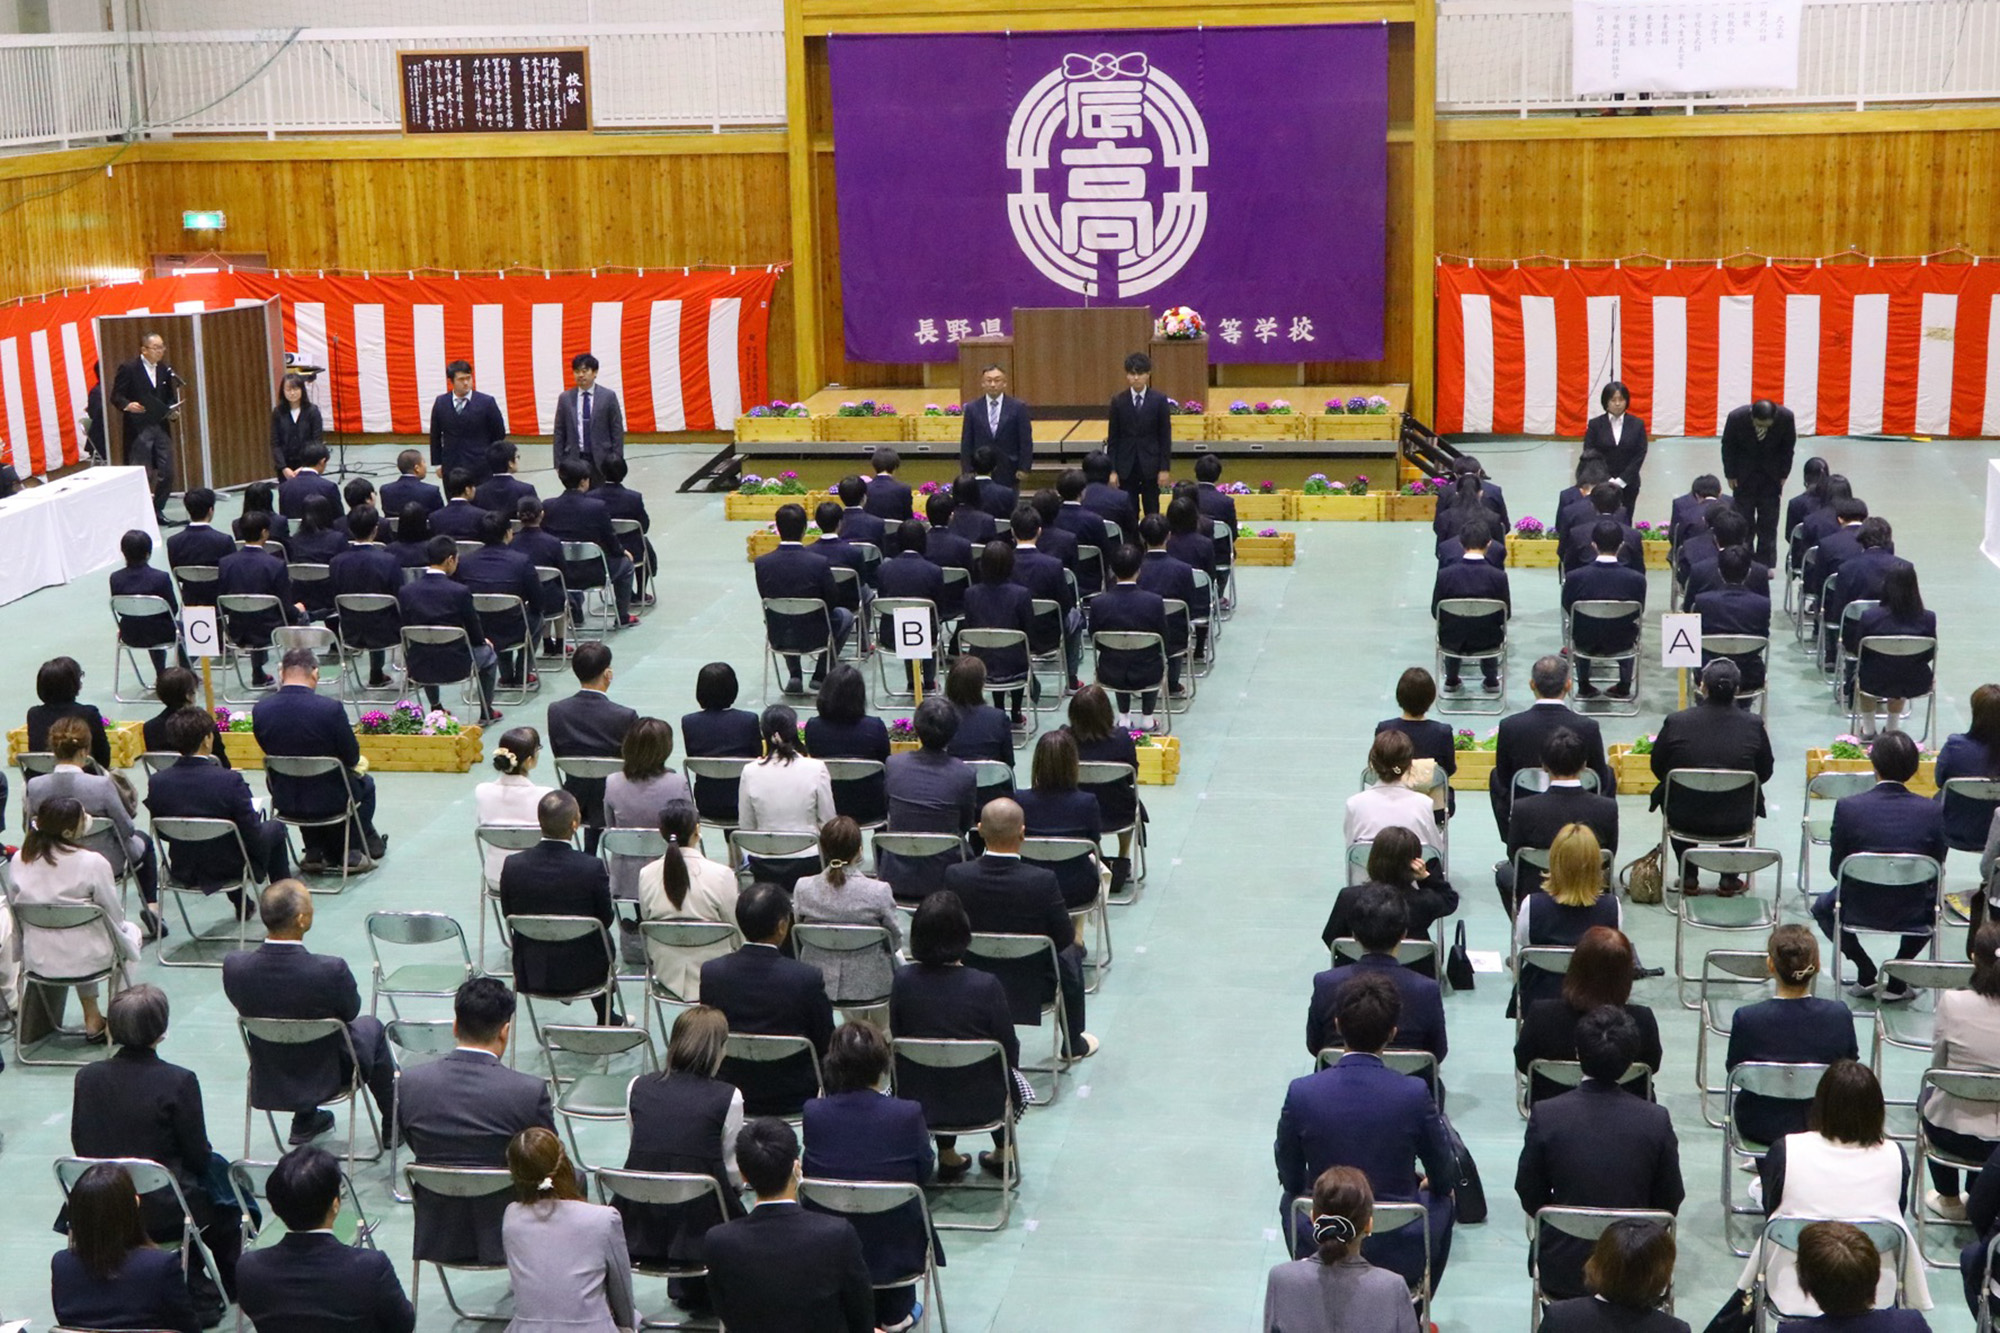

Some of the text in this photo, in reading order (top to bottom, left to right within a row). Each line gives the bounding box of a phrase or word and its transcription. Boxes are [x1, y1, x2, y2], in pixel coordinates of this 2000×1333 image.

[565, 72, 583, 105] 校歌
[914, 318, 1005, 345] 長野県
[189, 619, 212, 645] C
[902, 620, 924, 646] B
[1668, 628, 1695, 655] A
